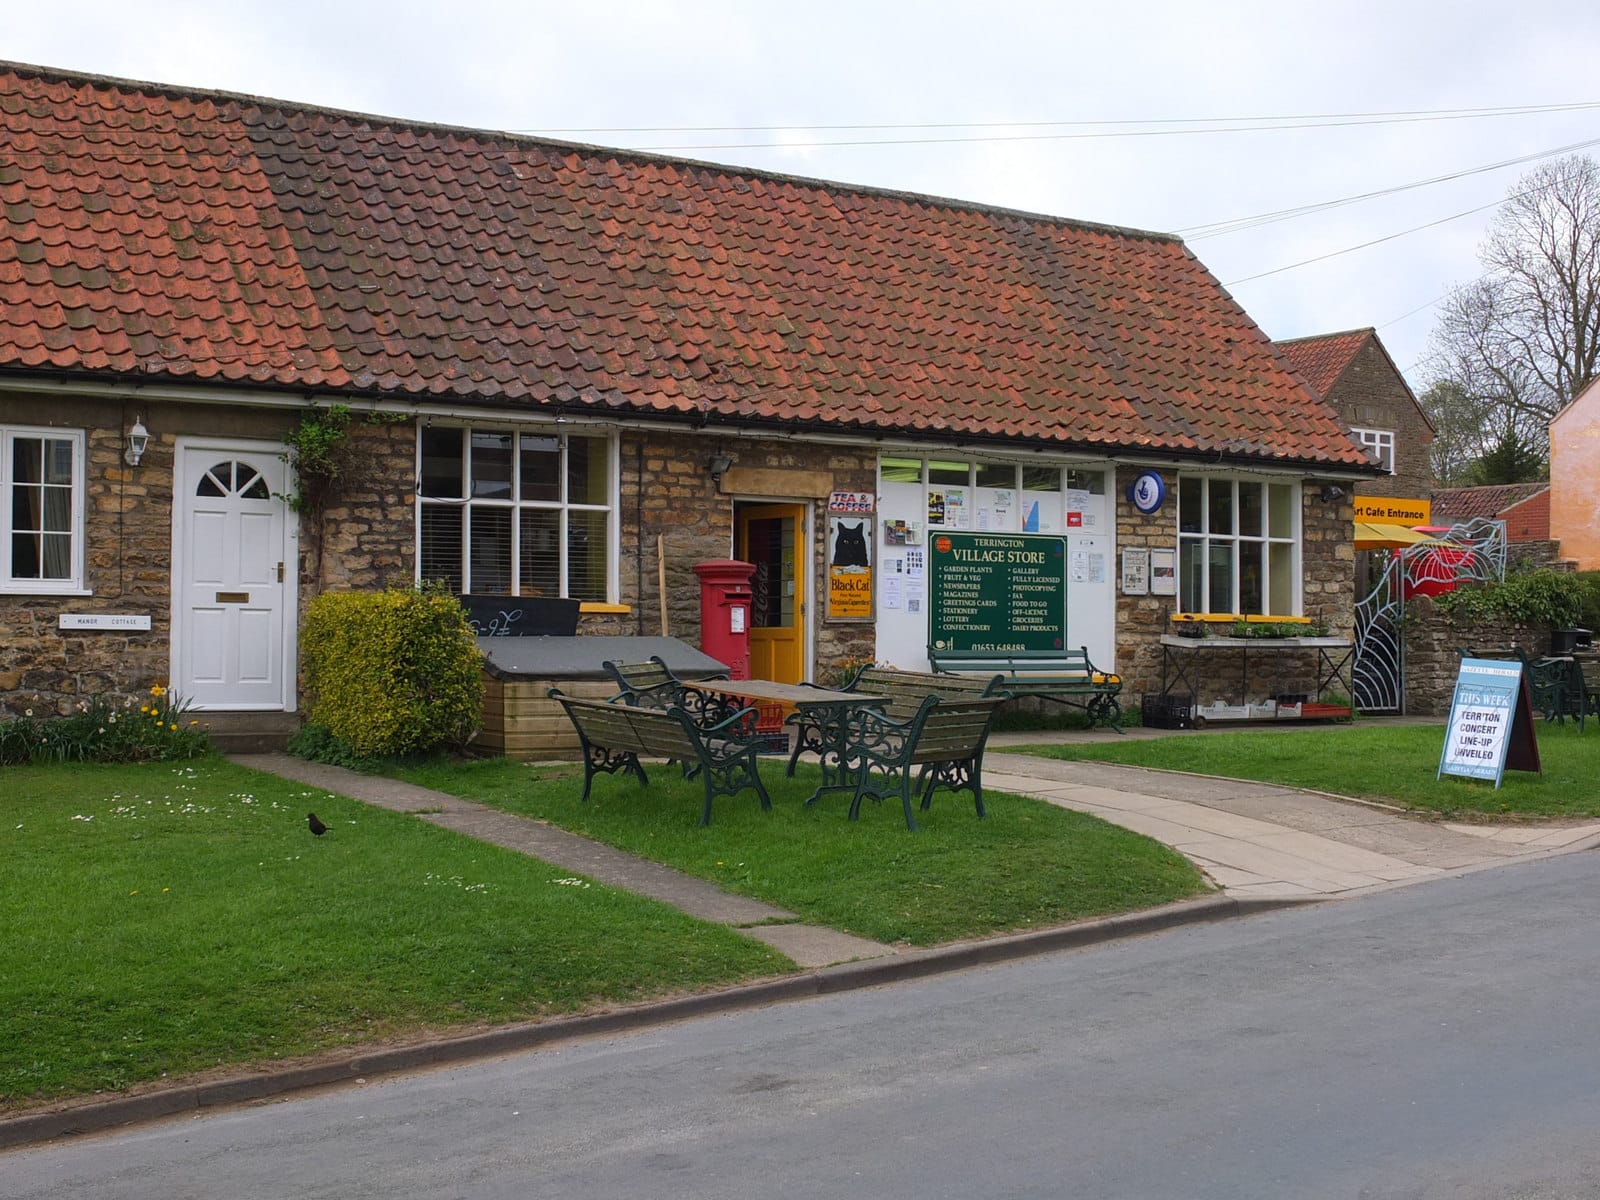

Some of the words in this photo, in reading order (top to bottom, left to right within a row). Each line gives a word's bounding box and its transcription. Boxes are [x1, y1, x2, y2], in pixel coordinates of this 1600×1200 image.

[834, 494, 856, 502] TEA
[860, 494, 868, 502] &
[830, 502, 871, 512] COFFEE
[1366, 508, 1384, 517] Cafe
[1388, 508, 1424, 519] Entrance
[974, 538, 1024, 548] TERRINGTON
[953, 549, 1004, 562] VILLAGE
[1008, 551, 1046, 564] STORE
[832, 579, 855, 591] Black
[856, 579, 869, 591] Cat
[972, 643, 995, 651] 01653
[1460, 693, 1481, 704] THIS
[1483, 694, 1509, 706] WEEK
[1461, 710, 1500, 722] TERR'TON
[1460, 723, 1497, 735] CONCERT
[1460, 736, 1493, 747] LINE-UP
[1454, 748, 1493, 759] UNVEILED
